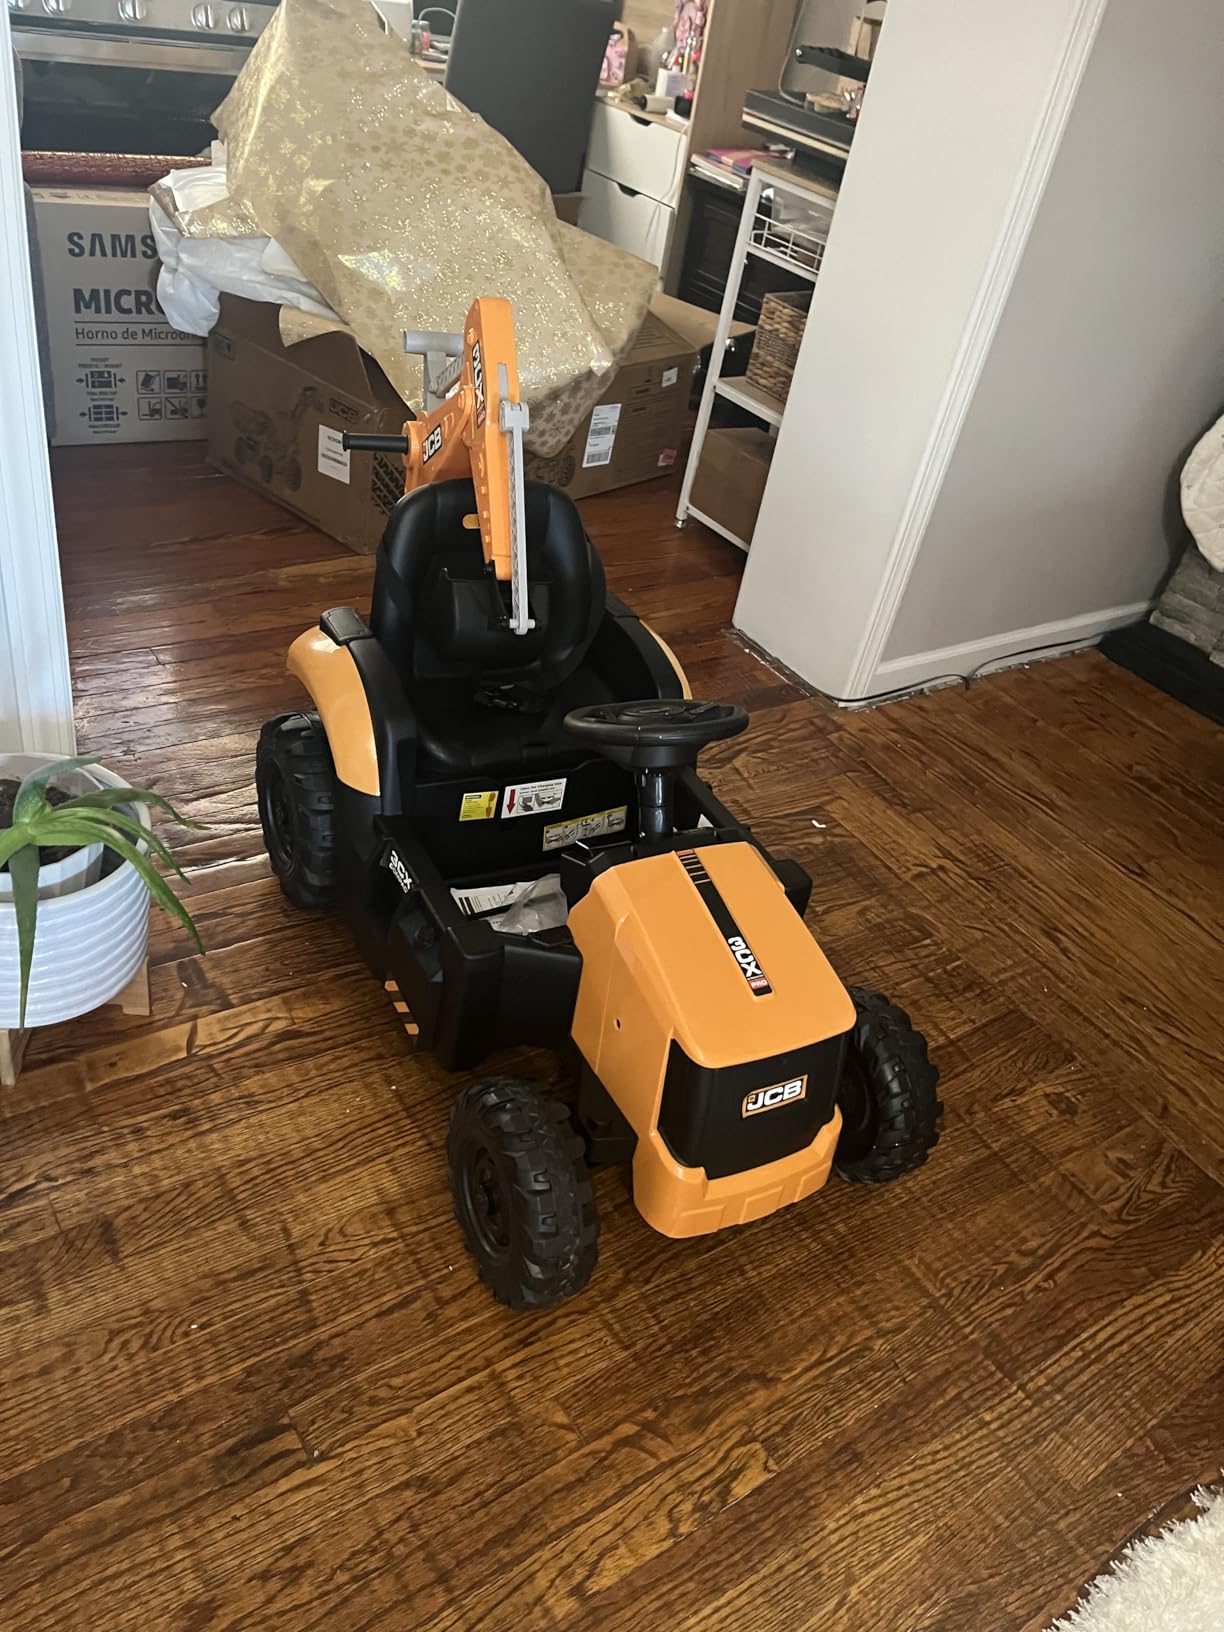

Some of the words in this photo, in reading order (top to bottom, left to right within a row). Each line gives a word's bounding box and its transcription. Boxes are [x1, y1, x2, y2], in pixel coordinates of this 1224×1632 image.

[73, 288, 165, 315] MICR
[75, 327, 118, 340] Horno
[121, 327, 138, 340] de
[472, 341, 484, 409] 3CX
[422, 426, 442, 462] JCB
[391, 850, 412, 890] 3CX
[728, 936, 763, 978] 3CX
[750, 979, 768, 989] PRO
[746, 1079, 802, 1111] JCB
